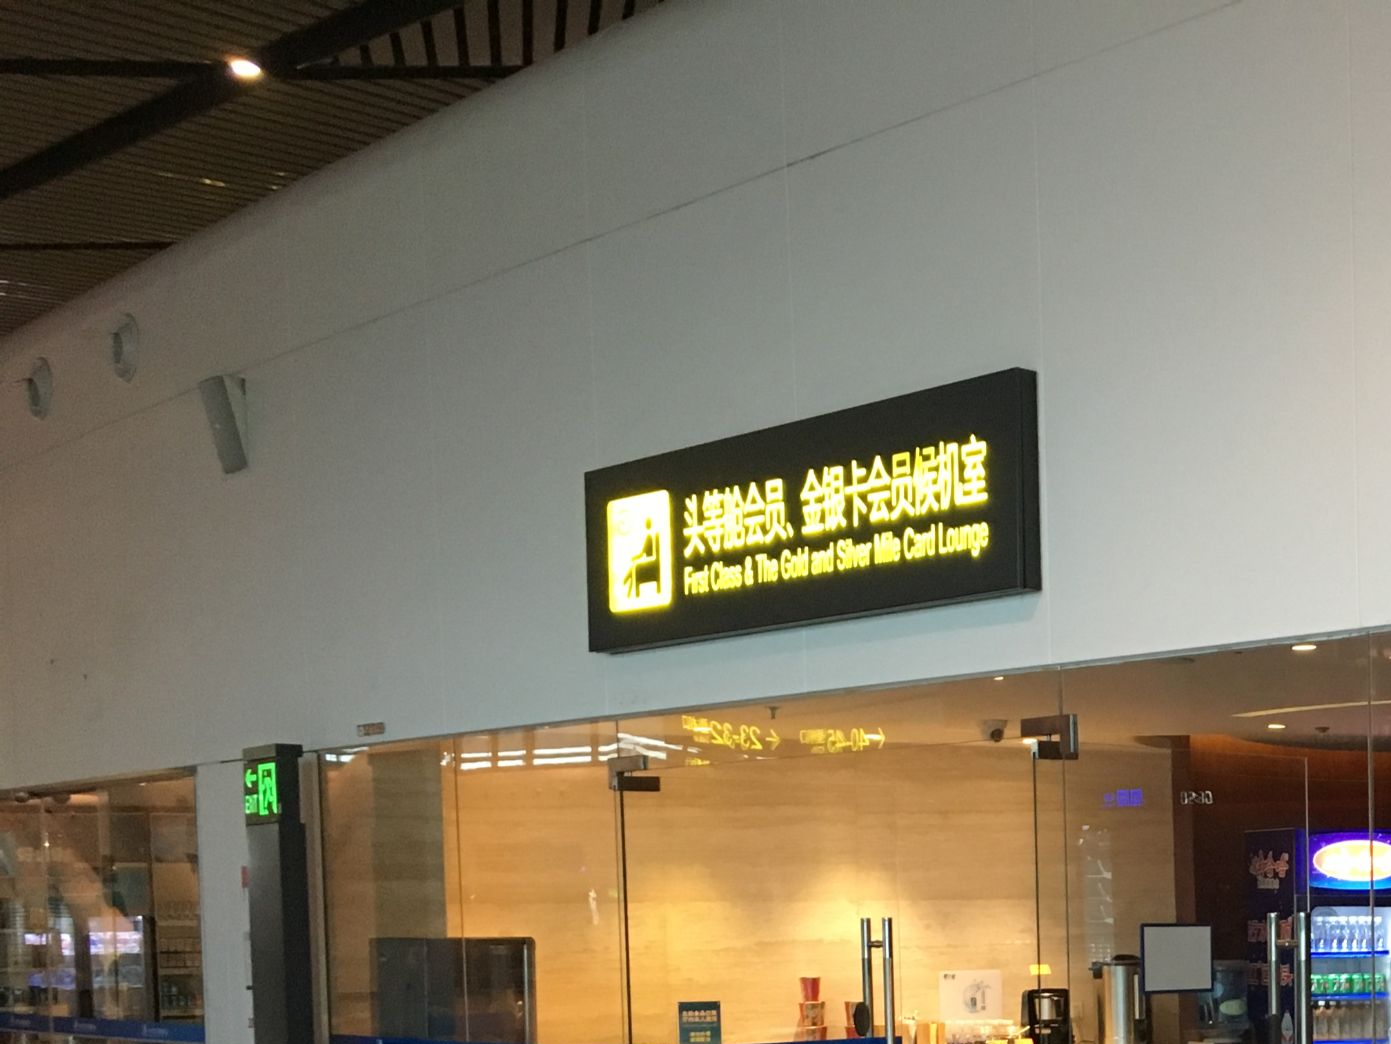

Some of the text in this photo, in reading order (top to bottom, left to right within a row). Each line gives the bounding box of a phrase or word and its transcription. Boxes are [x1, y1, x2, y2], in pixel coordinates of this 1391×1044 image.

[684, 566, 709, 596] First
[711, 561, 743, 591] Class
[744, 556, 754, 585] &
[756, 553, 778, 583] The
[781, 546, 810, 580] Gold
[811, 542, 835, 574] and
[837, 538, 872, 571] Silver
[904, 524, 936, 559] Card
[938, 521, 990, 557] Lounge
